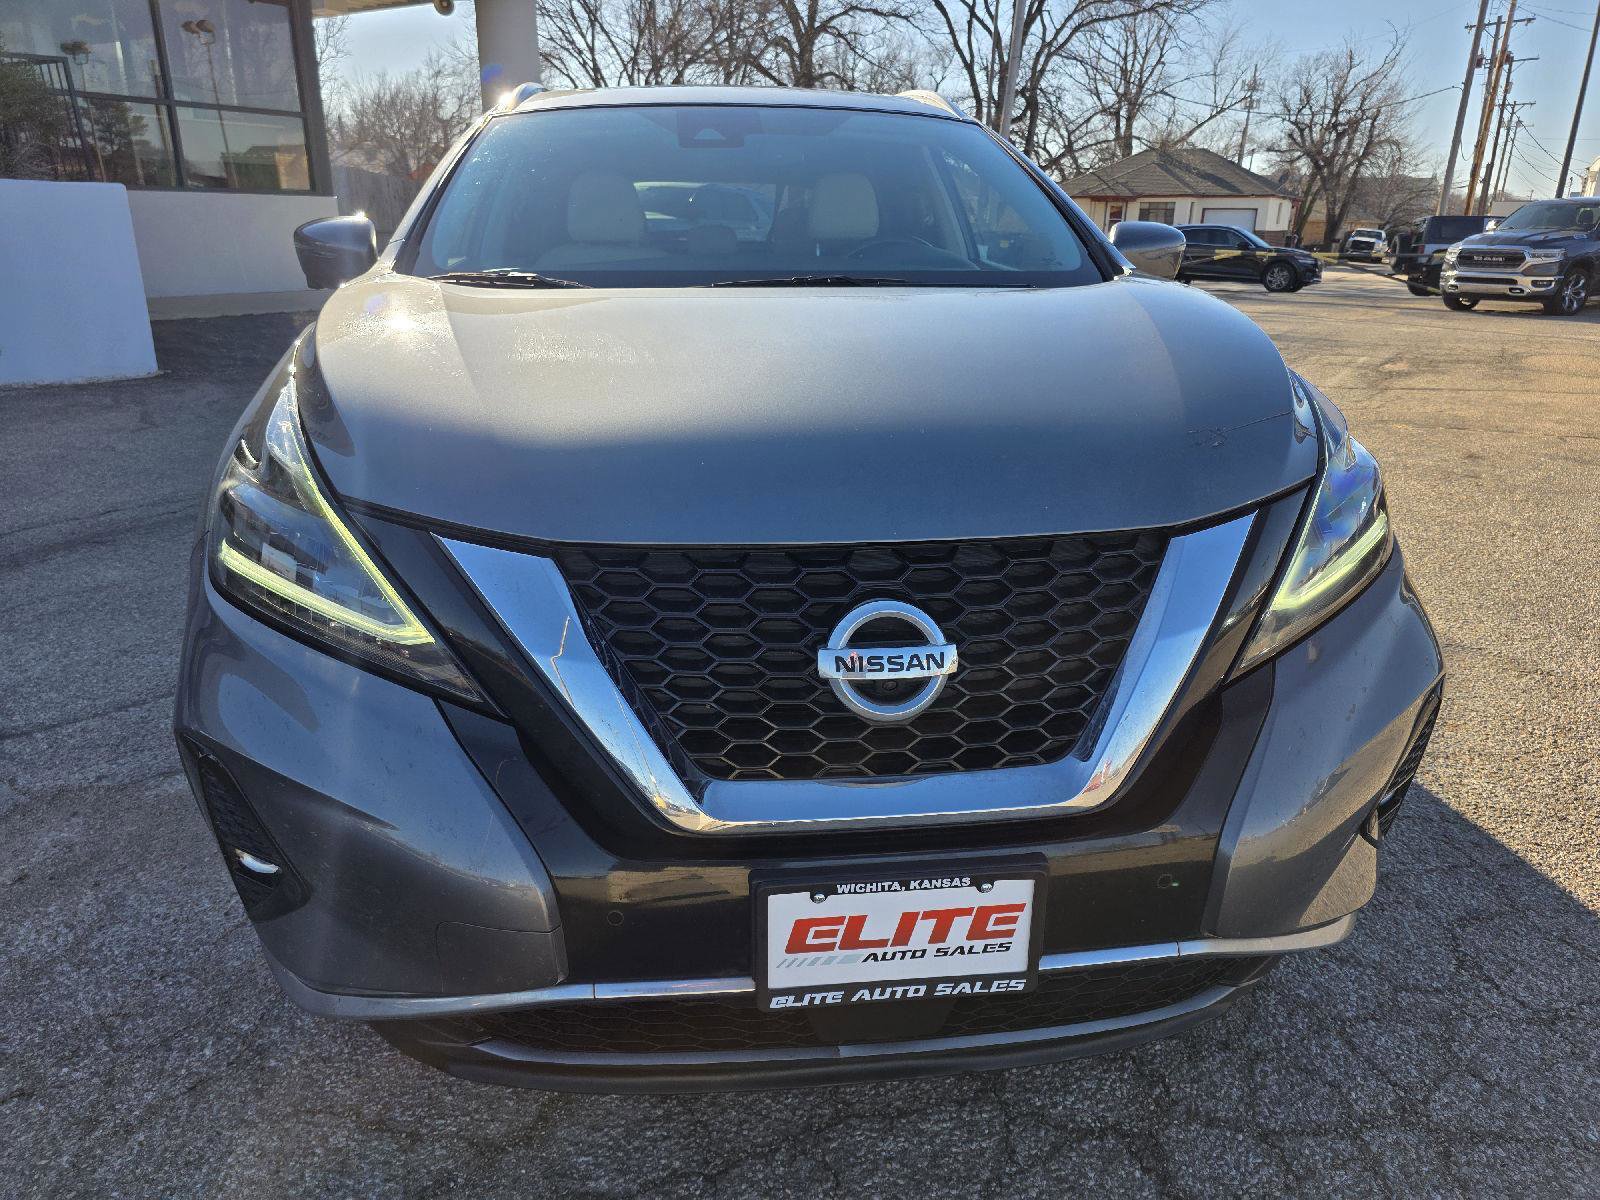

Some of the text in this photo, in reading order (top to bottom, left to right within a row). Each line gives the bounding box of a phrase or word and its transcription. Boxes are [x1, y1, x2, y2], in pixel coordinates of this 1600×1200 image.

[834, 651, 945, 673] NISSAN
[836, 876, 971, 894] WICHITA, KANSAS
[784, 903, 1027, 954] ELITE
[861, 941, 1013, 963] AUTO SALES
[769, 979, 1026, 1009] ELITE AUTO SALES
